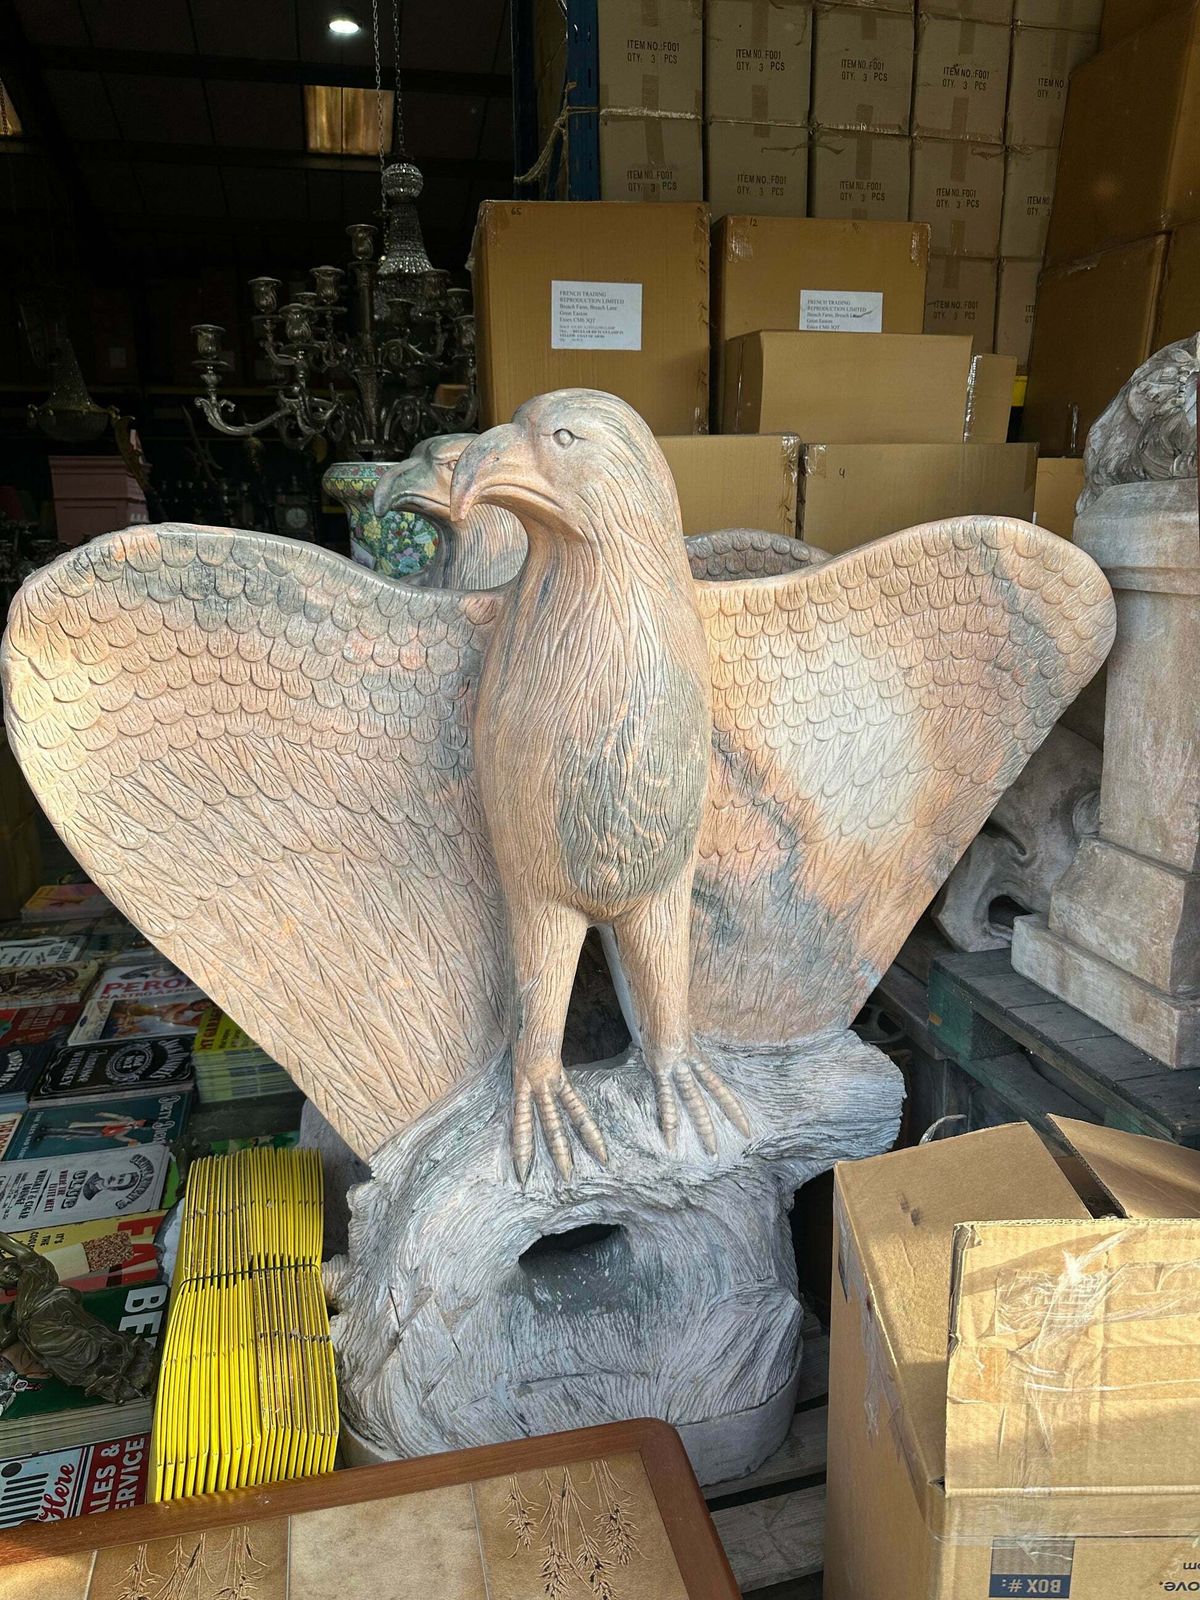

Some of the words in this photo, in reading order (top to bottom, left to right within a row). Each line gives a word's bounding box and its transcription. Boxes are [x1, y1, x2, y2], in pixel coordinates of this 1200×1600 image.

[627, 40, 645, 50] ITEM
[735, 48, 752, 59] ITEM
[651, 54, 656, 63] 3
[664, 54, 678, 64] PCS
[841, 59, 857, 69] ITEM
[759, 63, 764, 72] 3
[770, 62, 785, 72] PCS
[943, 66, 960, 76] ITEM
[873, 72, 888, 82] PCS
[963, 80, 968, 90] 3
[975, 80, 986, 91] PCS
[662, 181, 677, 191] PCS
[771, 186, 784, 196] PCS
[871, 192, 885, 201] PCS
[966, 199, 980, 209] PCS
[60, 1169, 89, 1209] CLUB
[100, 1443, 121, 1457] &
[38, 1462, 75, 1521] Here
[1027, 1578, 1062, 1594] BOX
